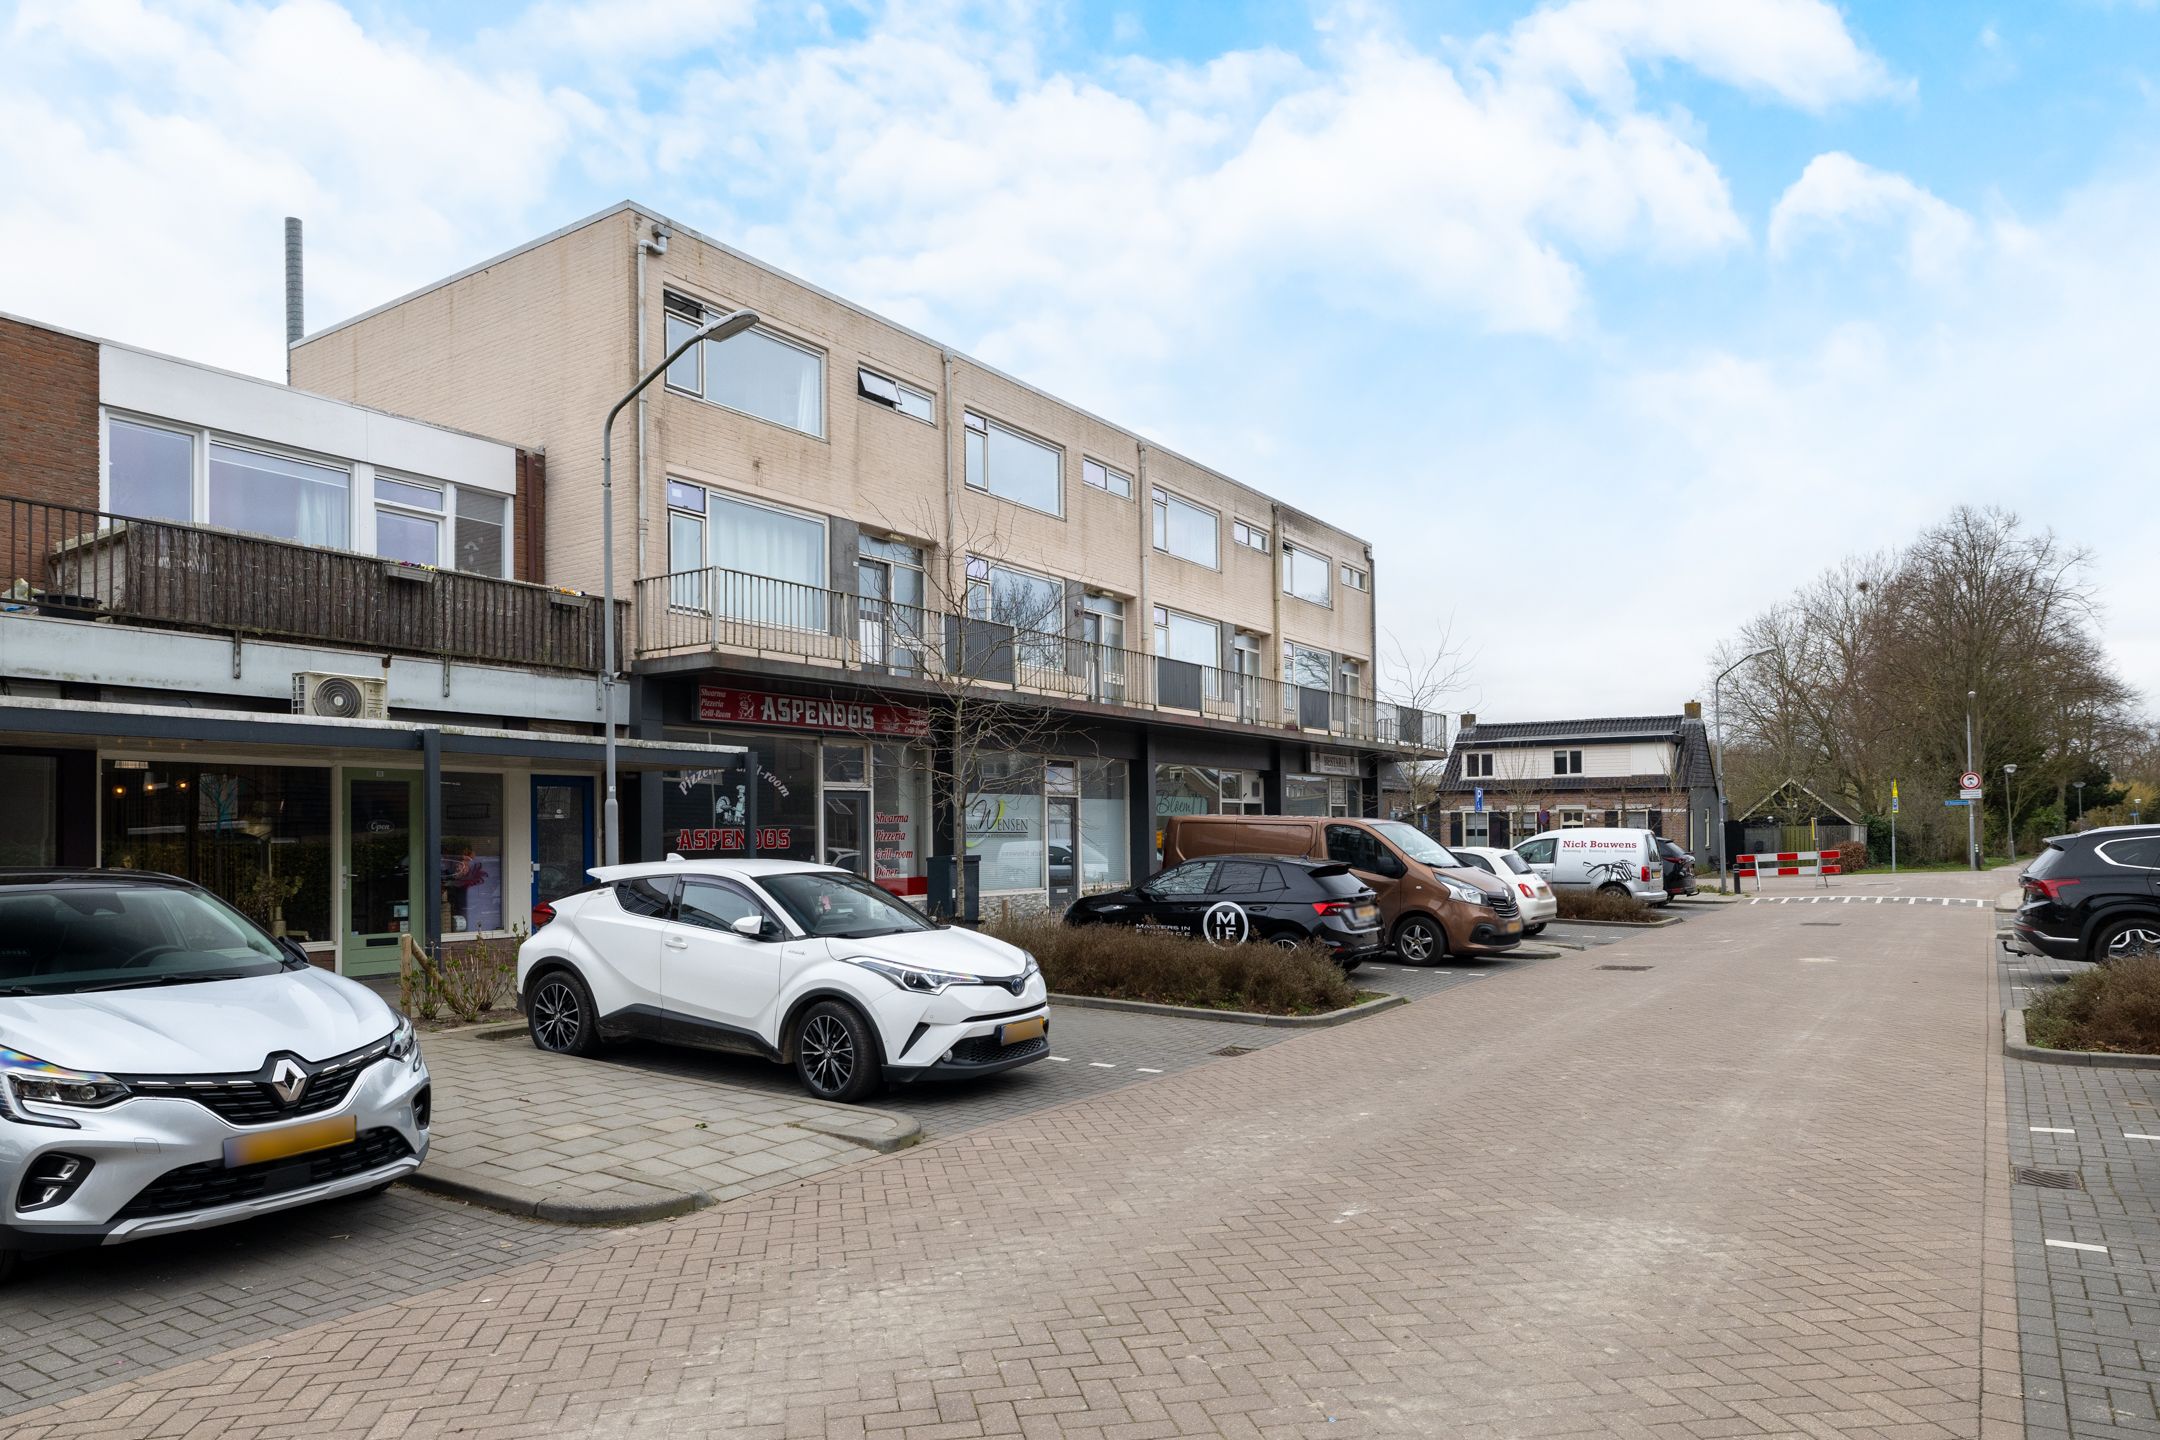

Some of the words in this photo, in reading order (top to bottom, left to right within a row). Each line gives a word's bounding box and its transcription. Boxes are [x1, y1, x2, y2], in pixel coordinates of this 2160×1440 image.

[700, 688, 727, 698] Shoarma
[700, 698, 724, 708] Pizzeria
[701, 708, 731, 719] Grill-Room
[760, 696, 875, 730] ASPENDOS
[679, 769, 725, 796] Pizzer
[874, 811, 909, 824] Shoarma
[875, 829, 907, 842] Pizzeria
[875, 847, 914, 861] Grill-room
